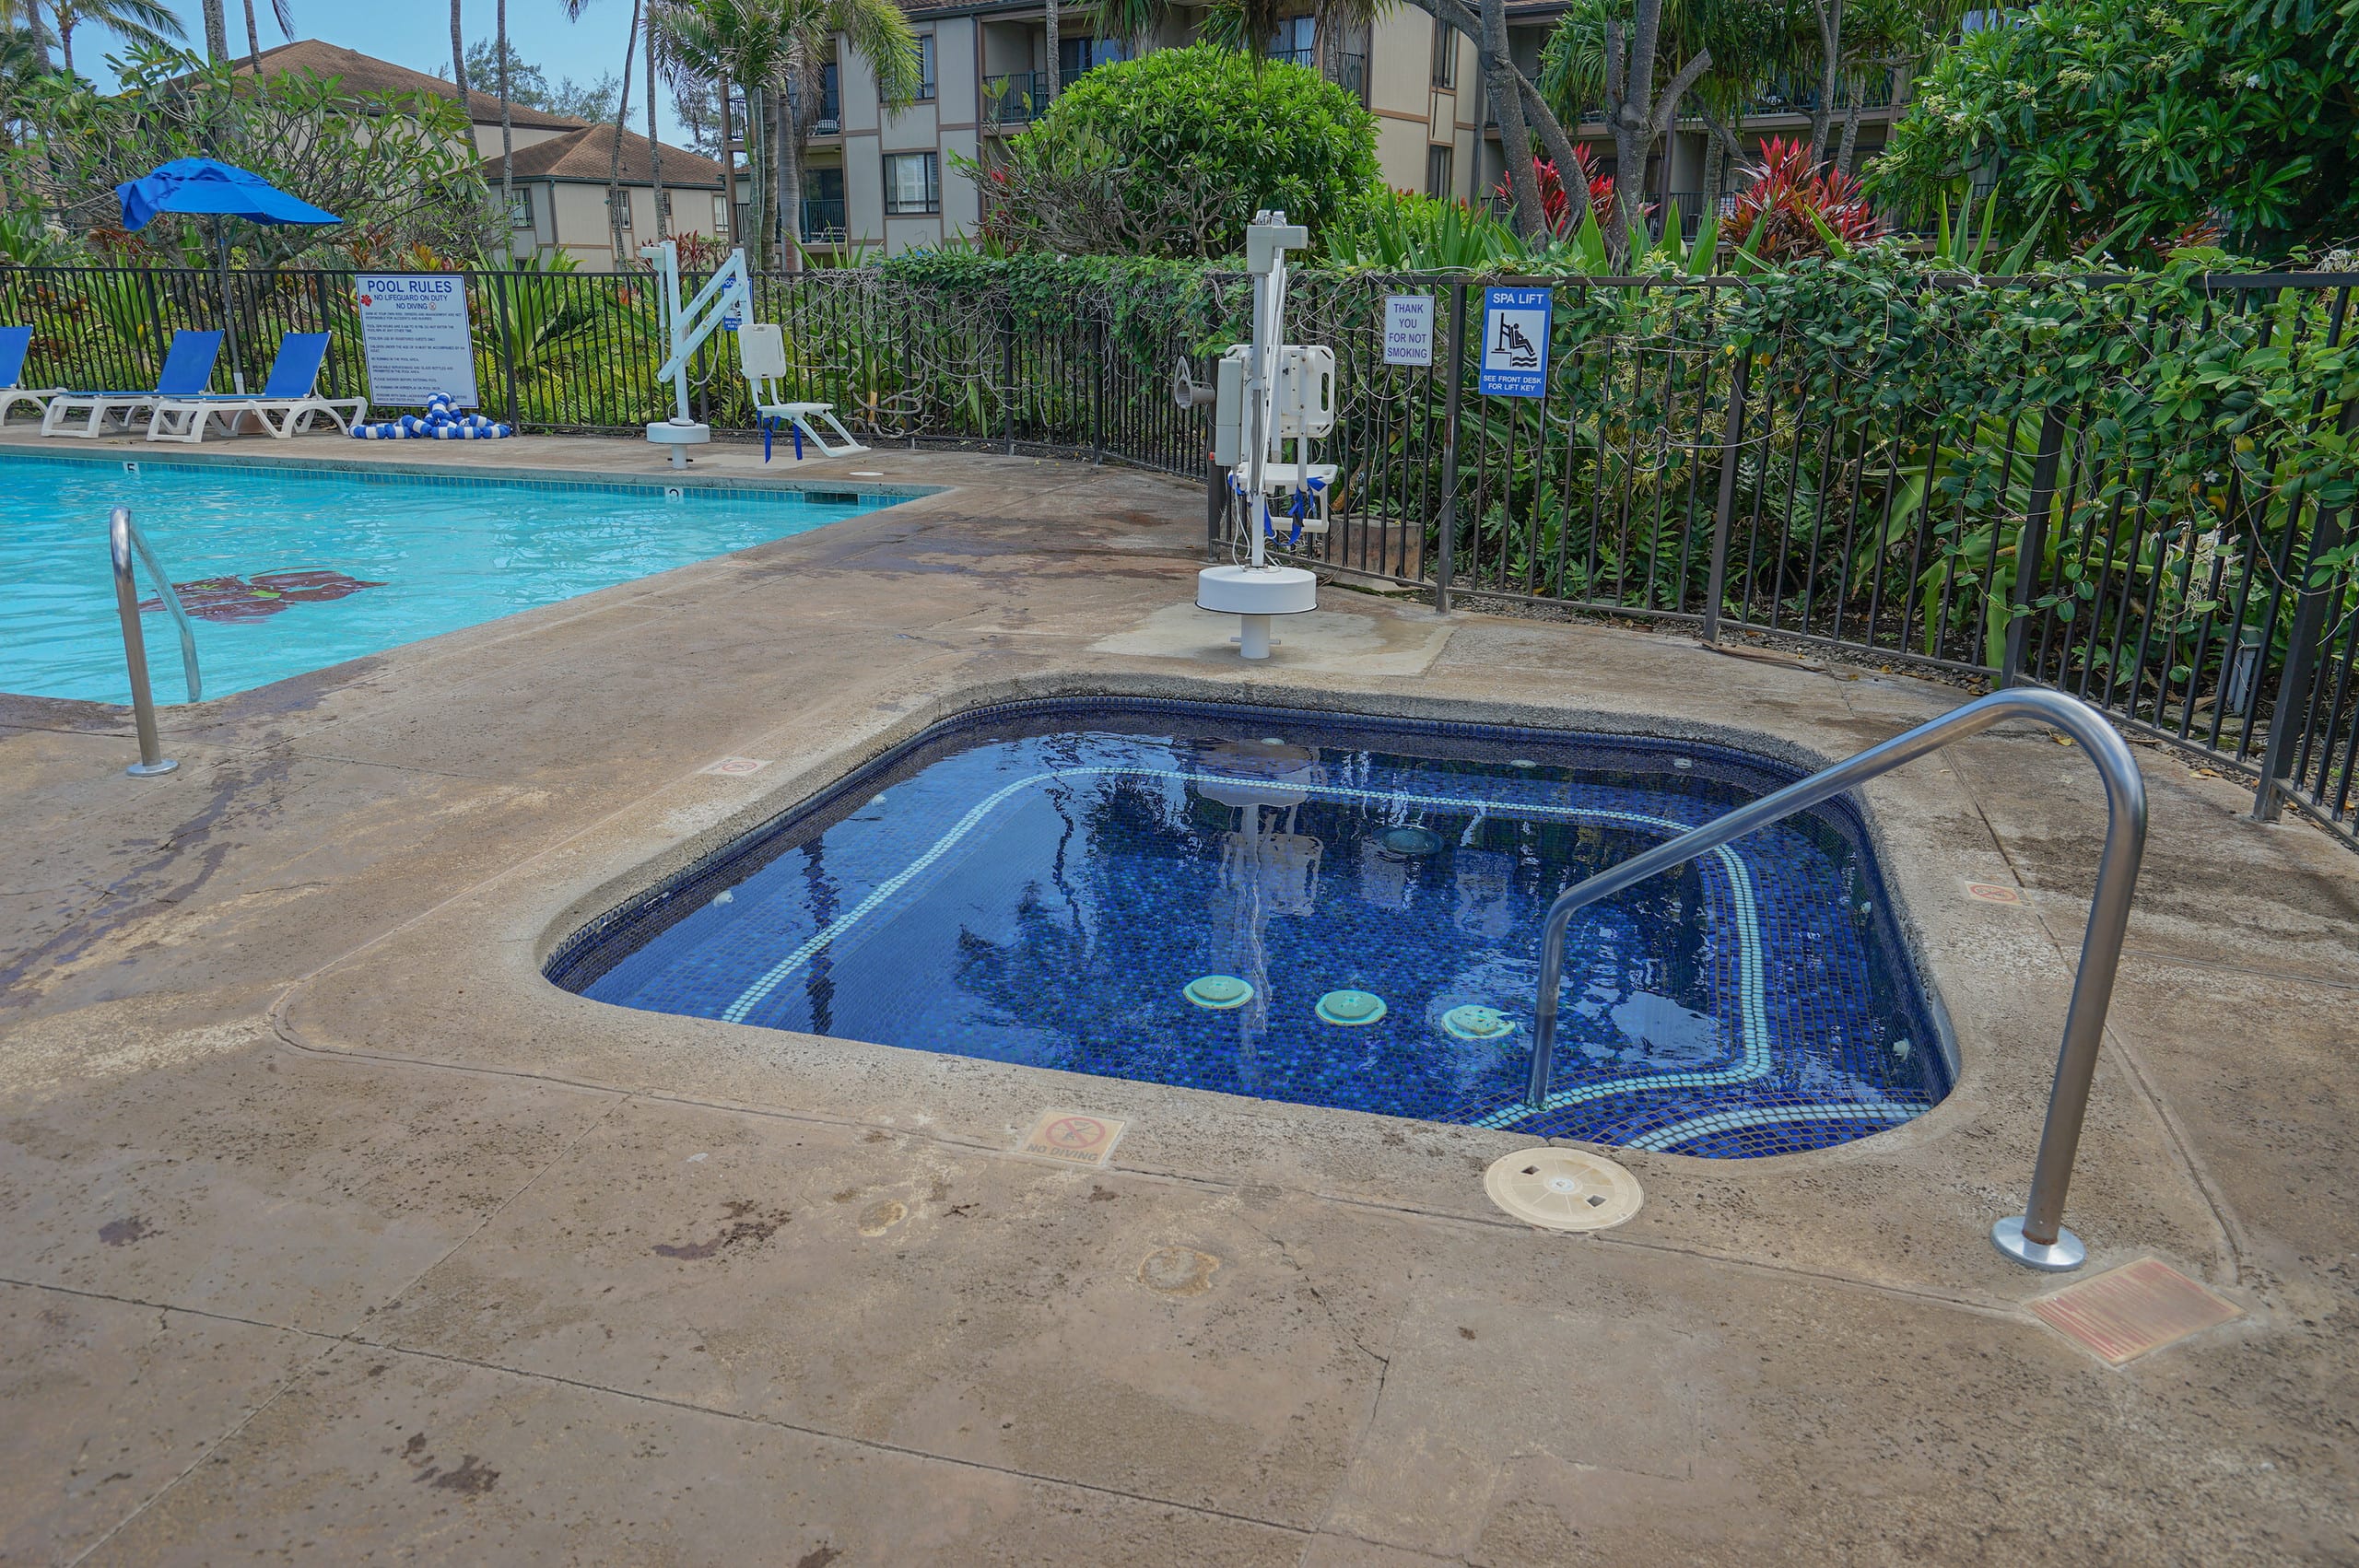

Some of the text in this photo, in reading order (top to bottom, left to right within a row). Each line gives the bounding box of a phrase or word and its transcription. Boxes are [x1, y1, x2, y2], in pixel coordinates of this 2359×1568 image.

[368, 280, 452, 293] POOL RULES
[1493, 293, 1544, 305] SPA LIFT
[406, 302, 428, 310] DIVING
[1394, 303, 1424, 314] THANK
[1399, 318, 1417, 329] YOU
[1389, 333, 1427, 344] FOR NOT
[1387, 346, 1427, 358] SMOKING
[1483, 374, 1542, 384] SEE FRONT DESK
[1488, 382, 1503, 391] FOR
[1504, 383, 1520, 392] LIFT
[1026, 1142, 1098, 1161] NO DIVING
